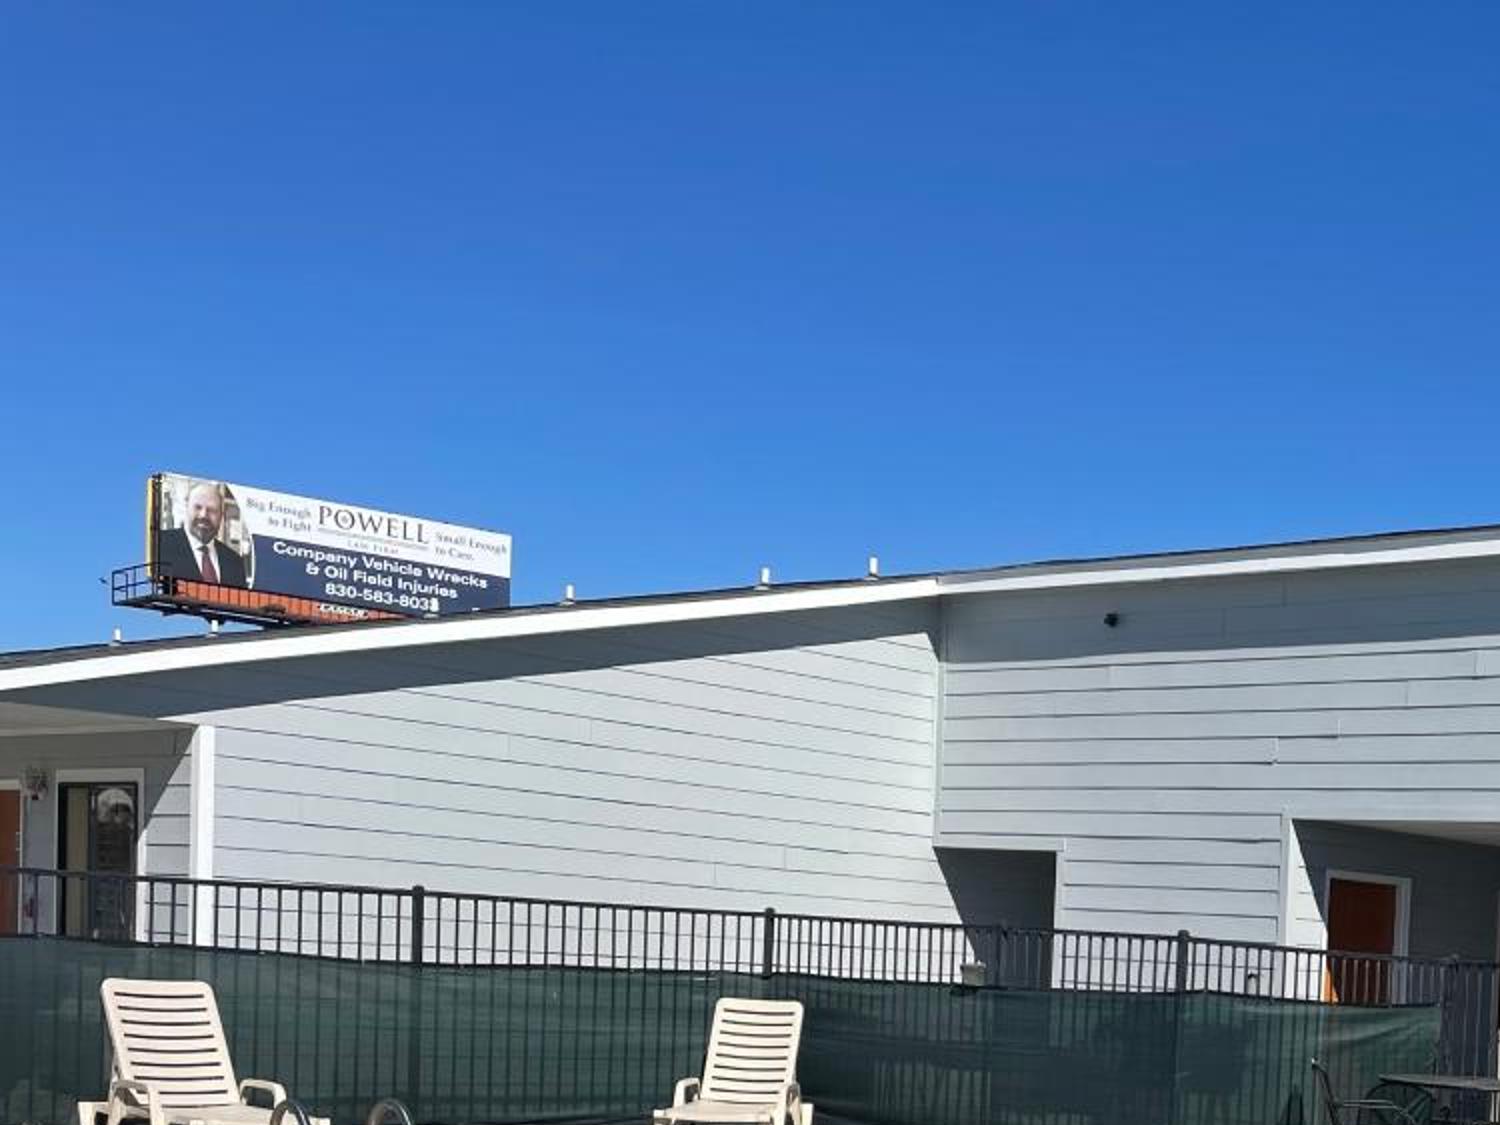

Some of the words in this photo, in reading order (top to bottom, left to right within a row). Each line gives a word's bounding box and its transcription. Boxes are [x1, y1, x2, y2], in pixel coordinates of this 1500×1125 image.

[269, 501, 311, 520] Enough
[283, 518, 311, 532] Fight
[318, 505, 429, 544] POWELL
[435, 531, 466, 546] Small
[469, 535, 507, 556] Enough
[273, 541, 358, 569] Company
[361, 555, 422, 577] Vehicle
[427, 567, 488, 589] Wrecks
[305, 562, 320, 575] &
[324, 564, 348, 581] Oil
[353, 569, 393, 588] Field
[397, 576, 459, 599] Injuries
